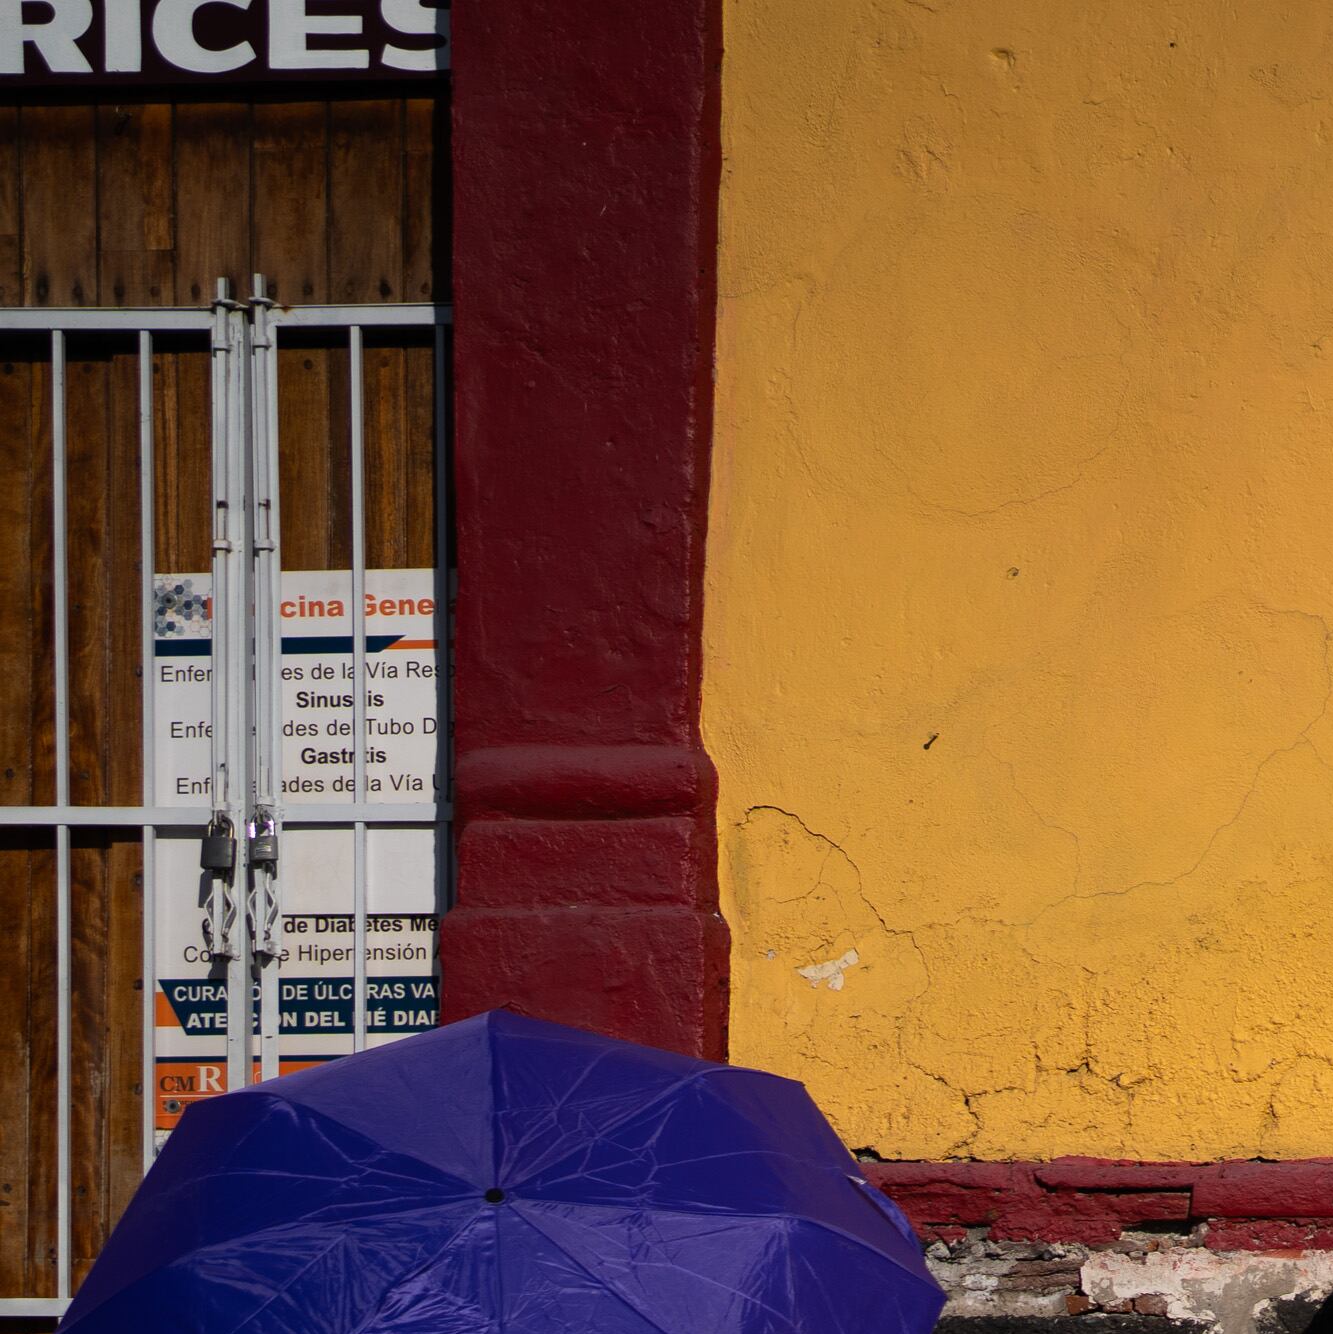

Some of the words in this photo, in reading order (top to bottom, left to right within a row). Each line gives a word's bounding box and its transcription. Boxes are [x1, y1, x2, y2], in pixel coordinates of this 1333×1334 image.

[311, 663, 335, 681] de
[342, 662, 355, 680] la
[366, 661, 398, 679] Vía
[296, 690, 385, 708] Sinusis
[365, 717, 414, 735] Tubo
[301, 746, 387, 765] Gastris
[333, 774, 356, 792] de
[366, 774, 382, 791] la
[389, 773, 424, 791] Vía
[284, 917, 308, 933] de
[299, 943, 427, 965] Hiperensión
[282, 984, 309, 1002] DE
[315, 979, 406, 1001] ÚLCRAS
[304, 1011, 347, 1029] DEL
